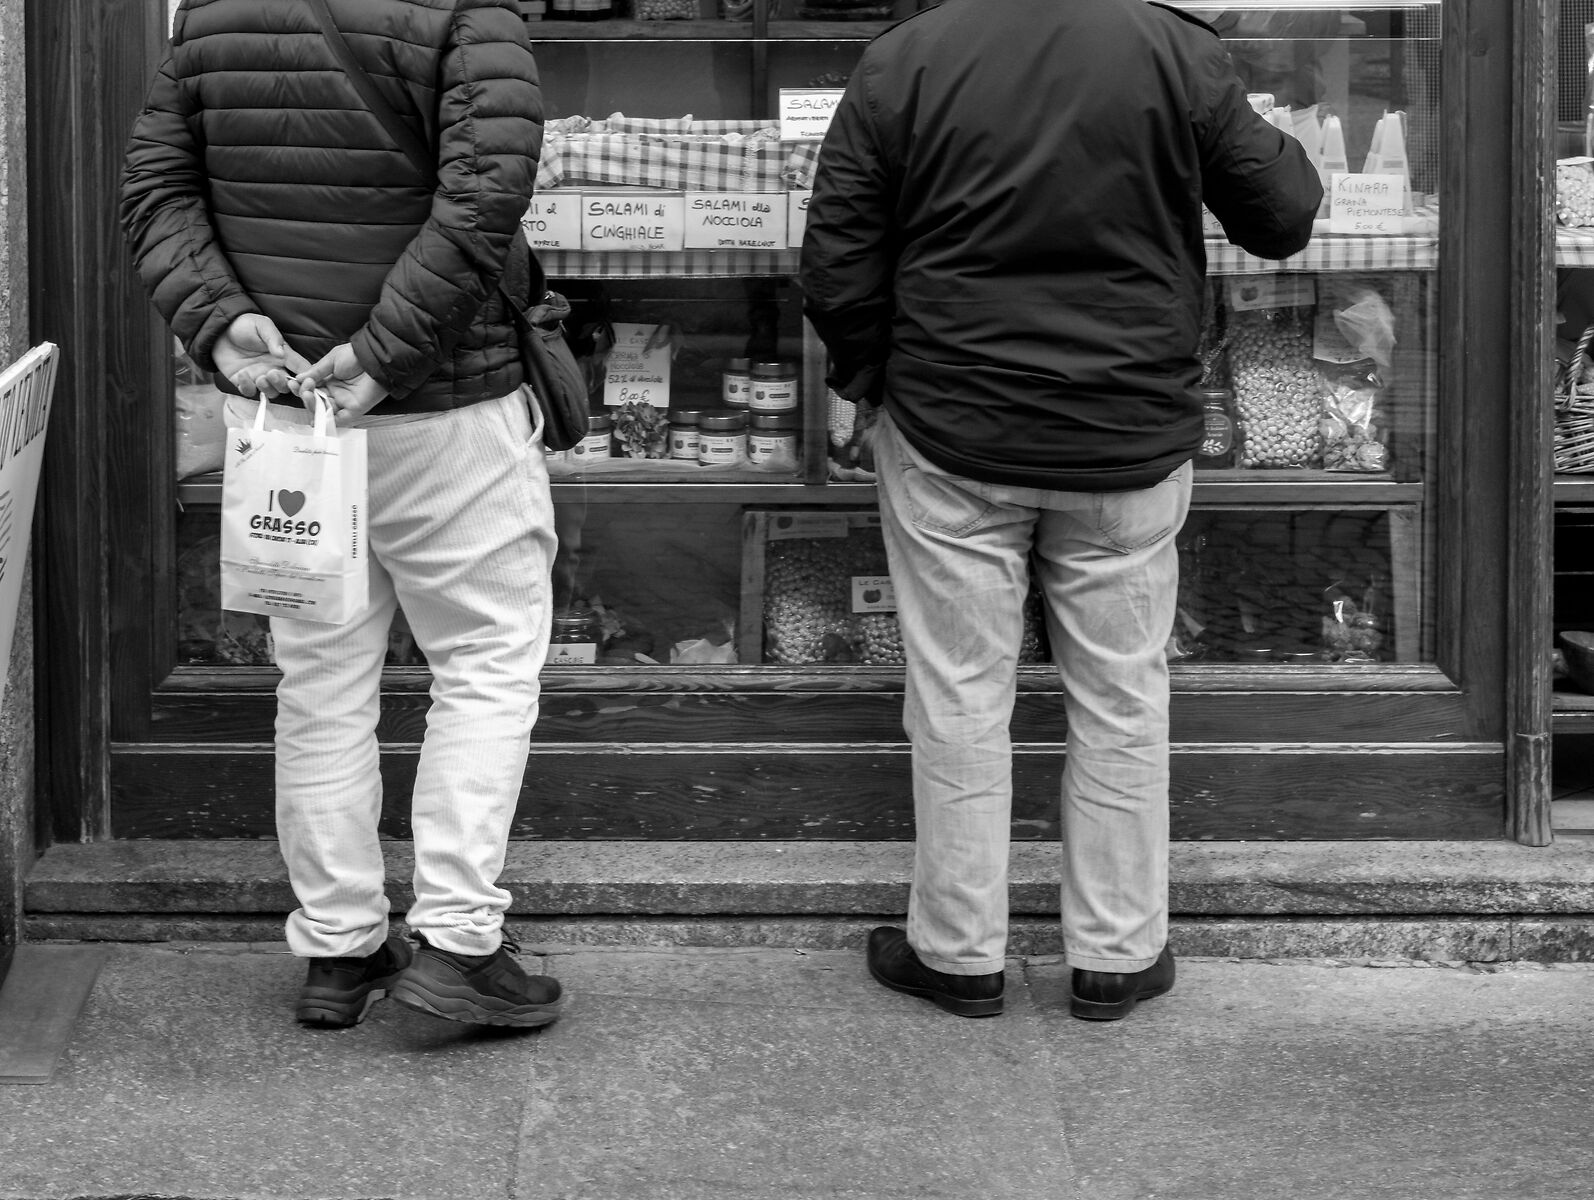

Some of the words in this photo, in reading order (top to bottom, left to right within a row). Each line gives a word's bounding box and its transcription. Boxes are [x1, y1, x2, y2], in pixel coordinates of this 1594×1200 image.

[787, 98, 838, 109] SALAM
[1337, 176, 1389, 195] KINARA
[588, 201, 649, 216] SALAMI
[654, 204, 666, 217] di
[692, 199, 746, 212] SALAMI
[1346, 208, 1404, 217] PIEMONTESE
[521, 220, 546, 232] RTO
[702, 215, 763, 228] NOCCIOLA
[590, 225, 665, 241] CINGHIALE
[268, 490, 274, 512] I
[250, 514, 321, 537] GRASSO
